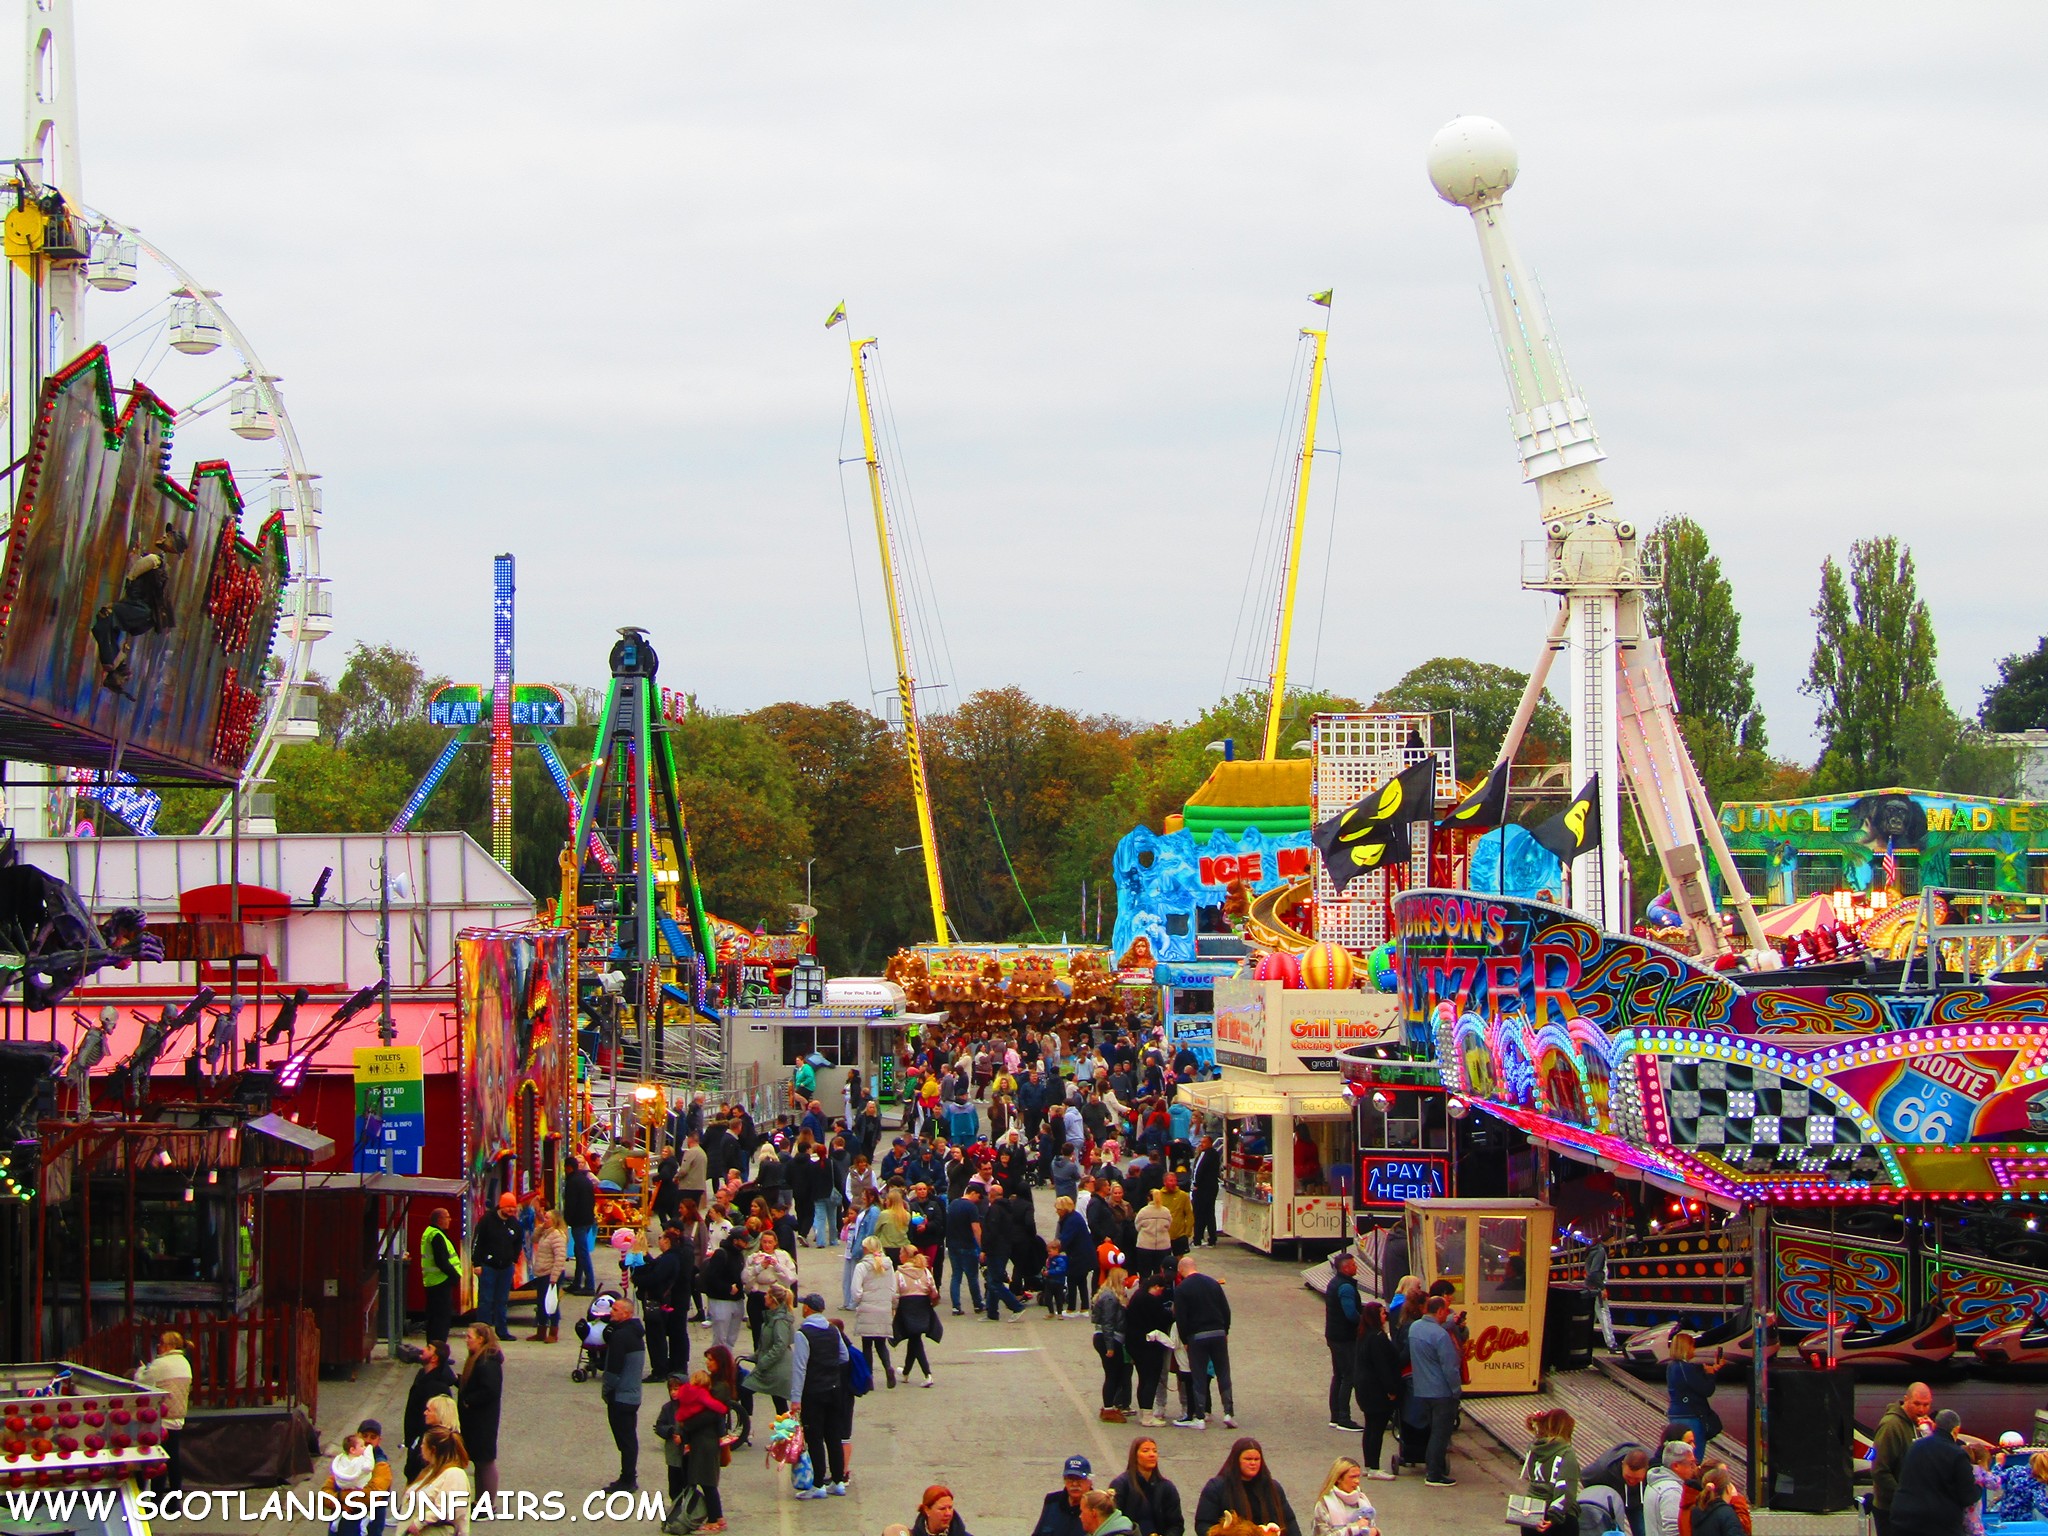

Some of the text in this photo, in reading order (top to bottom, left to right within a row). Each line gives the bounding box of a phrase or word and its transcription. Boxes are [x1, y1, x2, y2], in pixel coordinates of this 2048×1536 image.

[1729, 808, 2048, 833] JUNGLE MADNES
[1199, 852, 1262, 886] ICE
[1312, 1007, 1338, 1015] drink
[1343, 1008, 1372, 1017] enjoy
[1177, 1028, 1212, 1038] MAZE
[1290, 1018, 1380, 1039] Grill Time
[1291, 1040, 1332, 1052] Catering
[374, 1053, 401, 1062] TOILETS
[1311, 1059, 1334, 1070] great
[1913, 1053, 1988, 1098] ROUTE
[373, 1087, 405, 1096] FST AID
[1920, 1083, 1952, 1108] US
[1299, 1100, 1349, 1111] Tea Coffe
[1892, 1096, 1953, 1143] 66
[1386, 1162, 1423, 1179] PAY
[1377, 1183, 1433, 1200] HERE
[1475, 1325, 1530, 1363] Collins
[1484, 1361, 1525, 1370] FUN FAIRS
